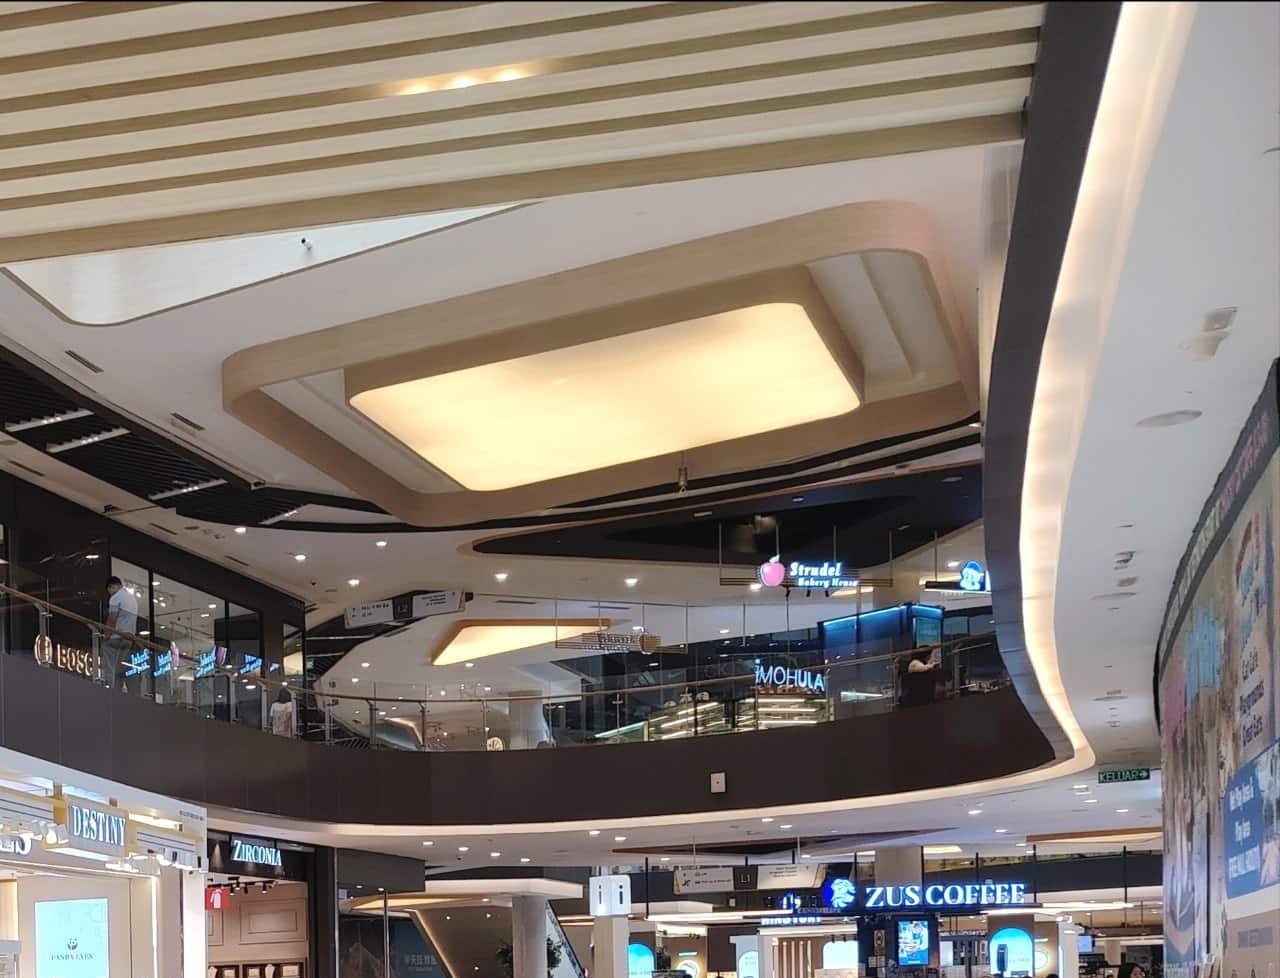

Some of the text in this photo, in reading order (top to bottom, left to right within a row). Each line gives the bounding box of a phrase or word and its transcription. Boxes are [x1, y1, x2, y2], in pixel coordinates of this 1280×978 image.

[790, 562, 841, 577] Strudel
[71, 805, 126, 847] DESTINY
[232, 839, 283, 867] ZIRCONIA
[865, 883, 1025, 908] ZUS COFFEE
